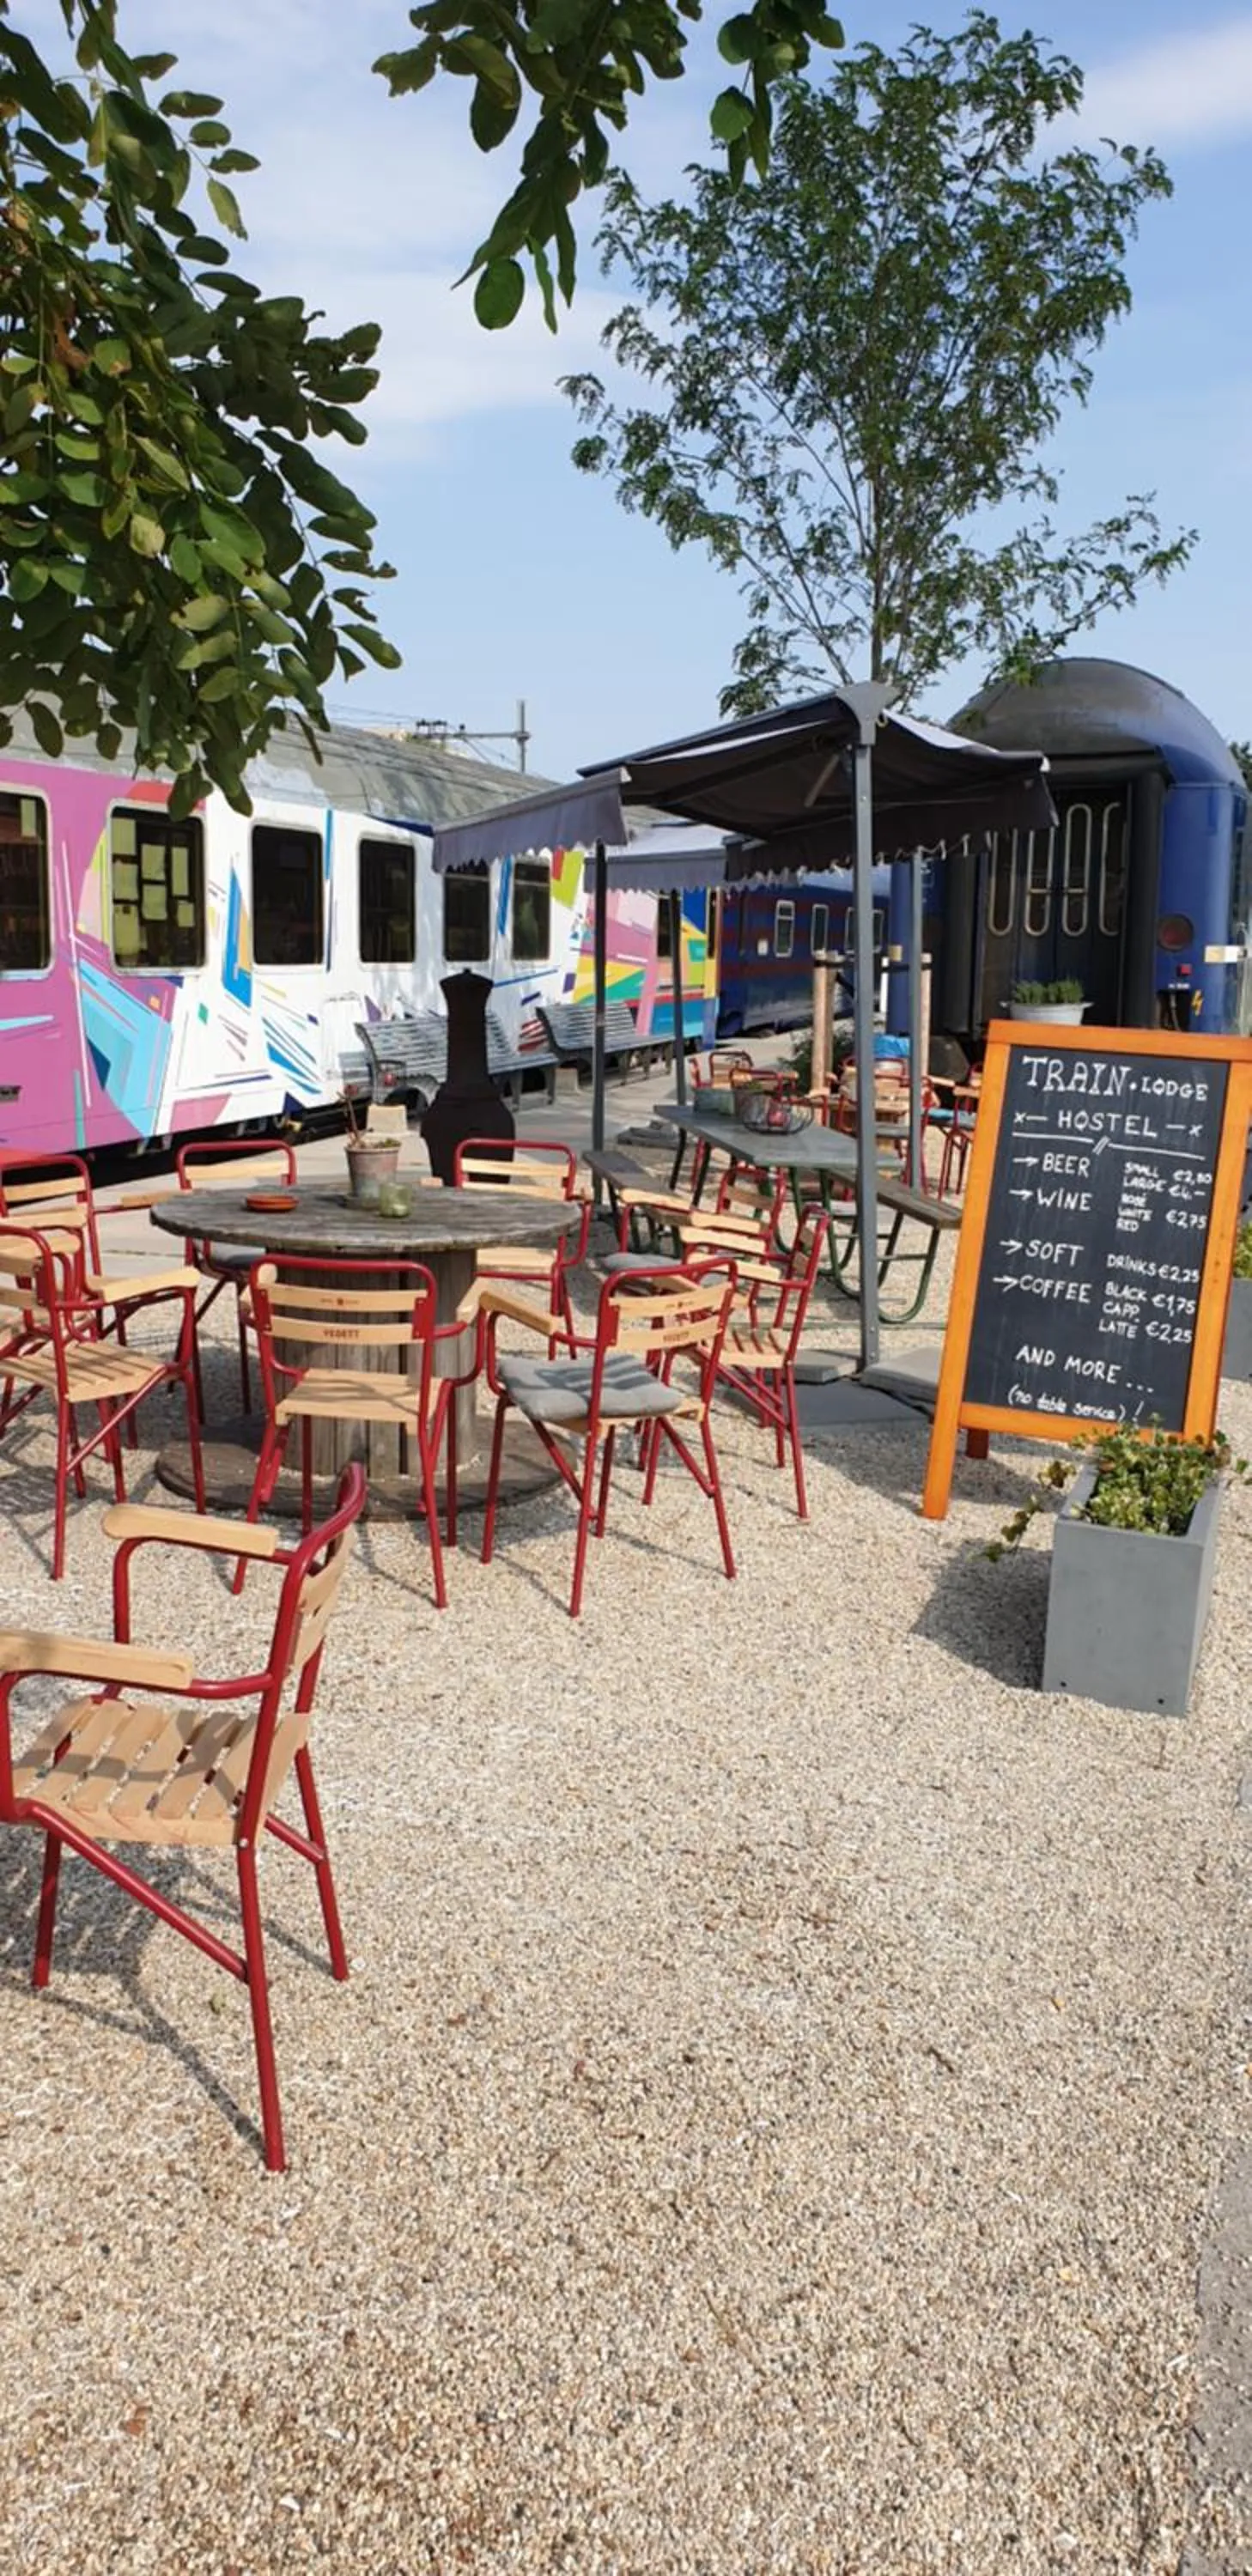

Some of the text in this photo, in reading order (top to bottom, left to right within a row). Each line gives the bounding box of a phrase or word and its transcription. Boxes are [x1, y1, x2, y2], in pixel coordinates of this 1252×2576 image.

[1058, 1109, 1158, 1138] HOSTEL
[1042, 1152, 1091, 1178] BEER
[1124, 1161, 1159, 1179] SMALL
[1123, 1176, 1167, 1193] LARGE
[1037, 1188, 1092, 1211] WINE
[1116, 1217, 1140, 1232] RED
[1165, 1209, 1207, 1230] €2,75
[1024, 1239, 1200, 1284] SOFT DRINKS €2,25
[1019, 1274, 1196, 1317] COFFEE BLACK €1,75
[1098, 1318, 1193, 1344] LATTE €2,25
[1016, 1345, 1055, 1367] AND
